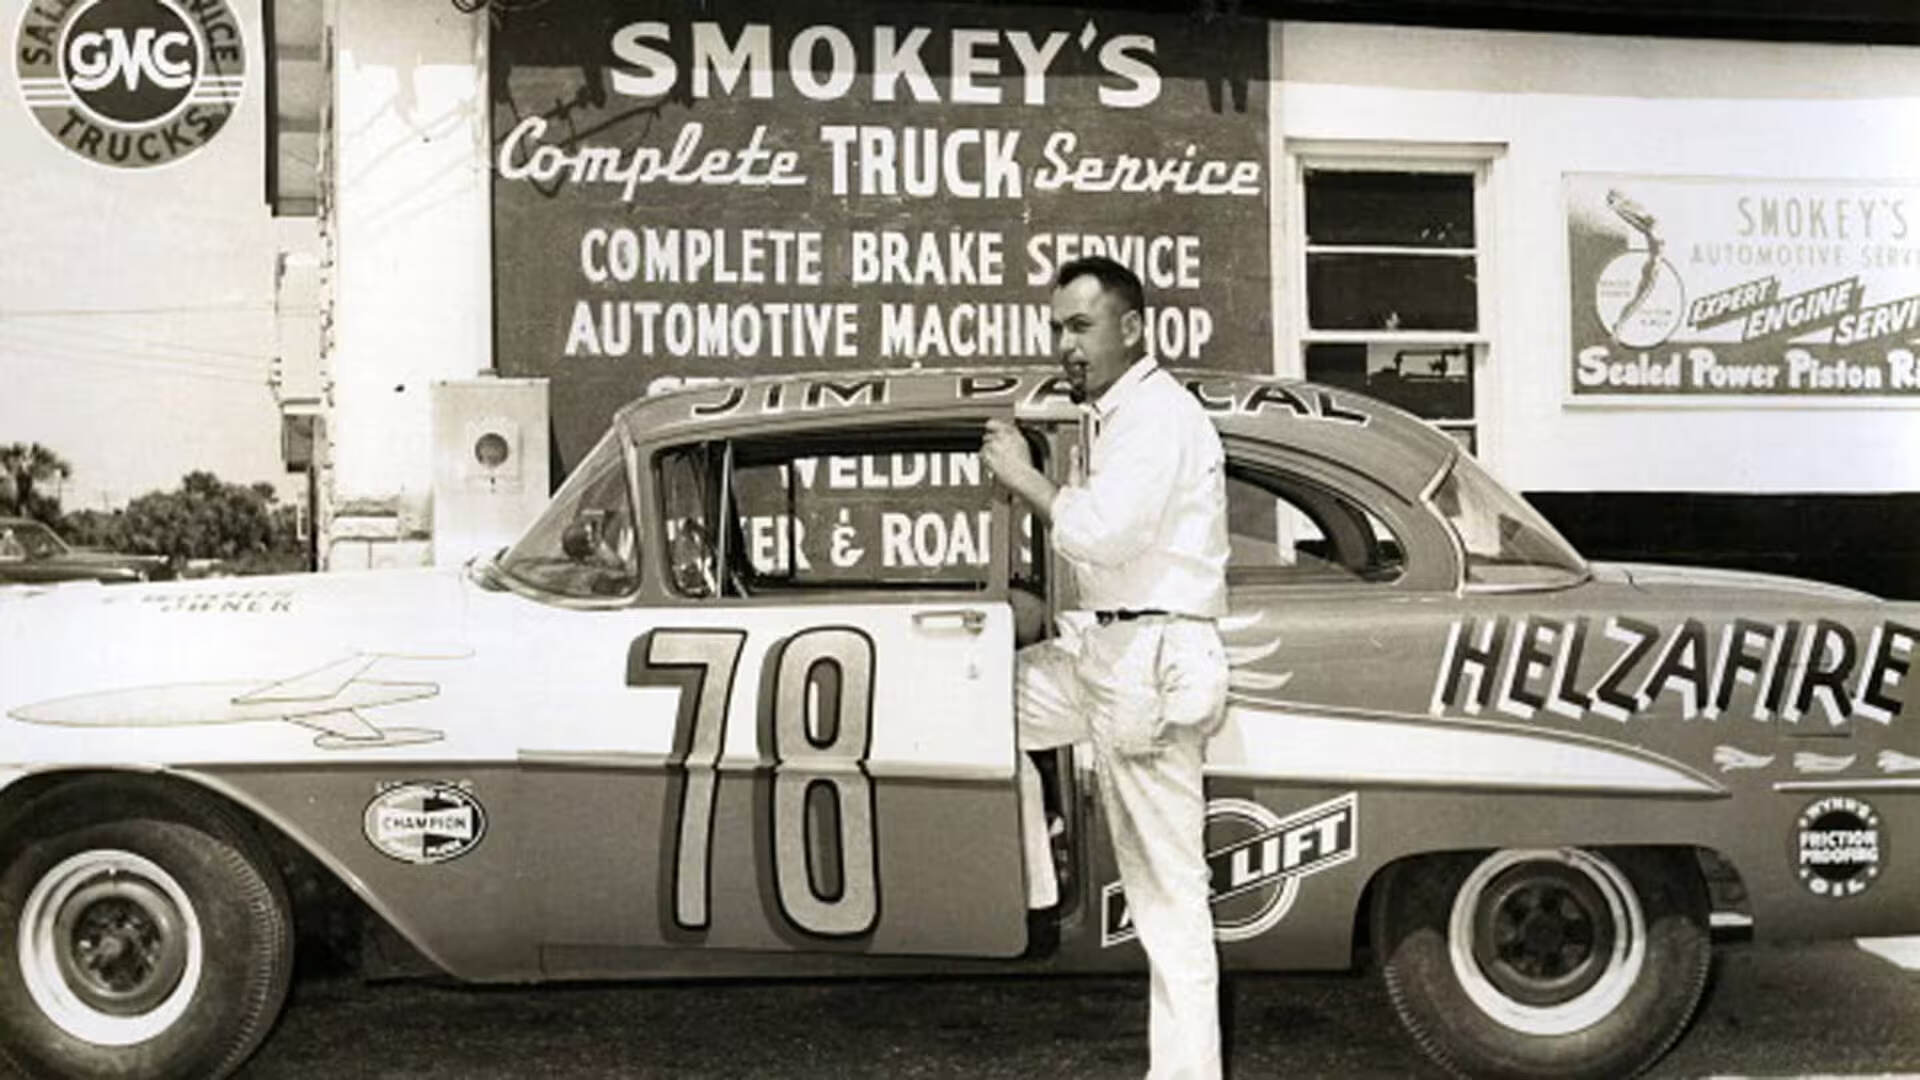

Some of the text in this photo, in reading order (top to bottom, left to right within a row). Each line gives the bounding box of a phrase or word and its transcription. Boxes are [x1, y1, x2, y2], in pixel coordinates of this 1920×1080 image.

[69, 28, 193, 91] GMC
[610, 20, 1162, 108] SMOKEY'S
[56, 107, 216, 162] TRUCKS
[499, 115, 1262, 202] Complete TRUCK Service
[1736, 196, 1909, 241] SMOKEY'S
[581, 227, 823, 286] COMPLETE
[852, 230, 1004, 285] BRAKE
[565, 300, 1213, 360] AUTOMOTIVE MACHIN OP
[1692, 279, 1773, 323] EXPERT
[1747, 281, 1853, 341] ENGINE
[1577, 346, 1681, 387] Sealed
[1689, 348, 1779, 388] Power
[1785, 348, 1882, 389] Piston
[690, 378, 891, 420] JIM
[956, 374, 1371, 427] PACAL
[1429, 616, 1920, 726] HELZAFIRE
[626, 624, 882, 943] 78
[383, 816, 467, 831] CHAMPION
[1230, 811, 1347, 888] LIFT
[1809, 878, 1865, 897] OIL
